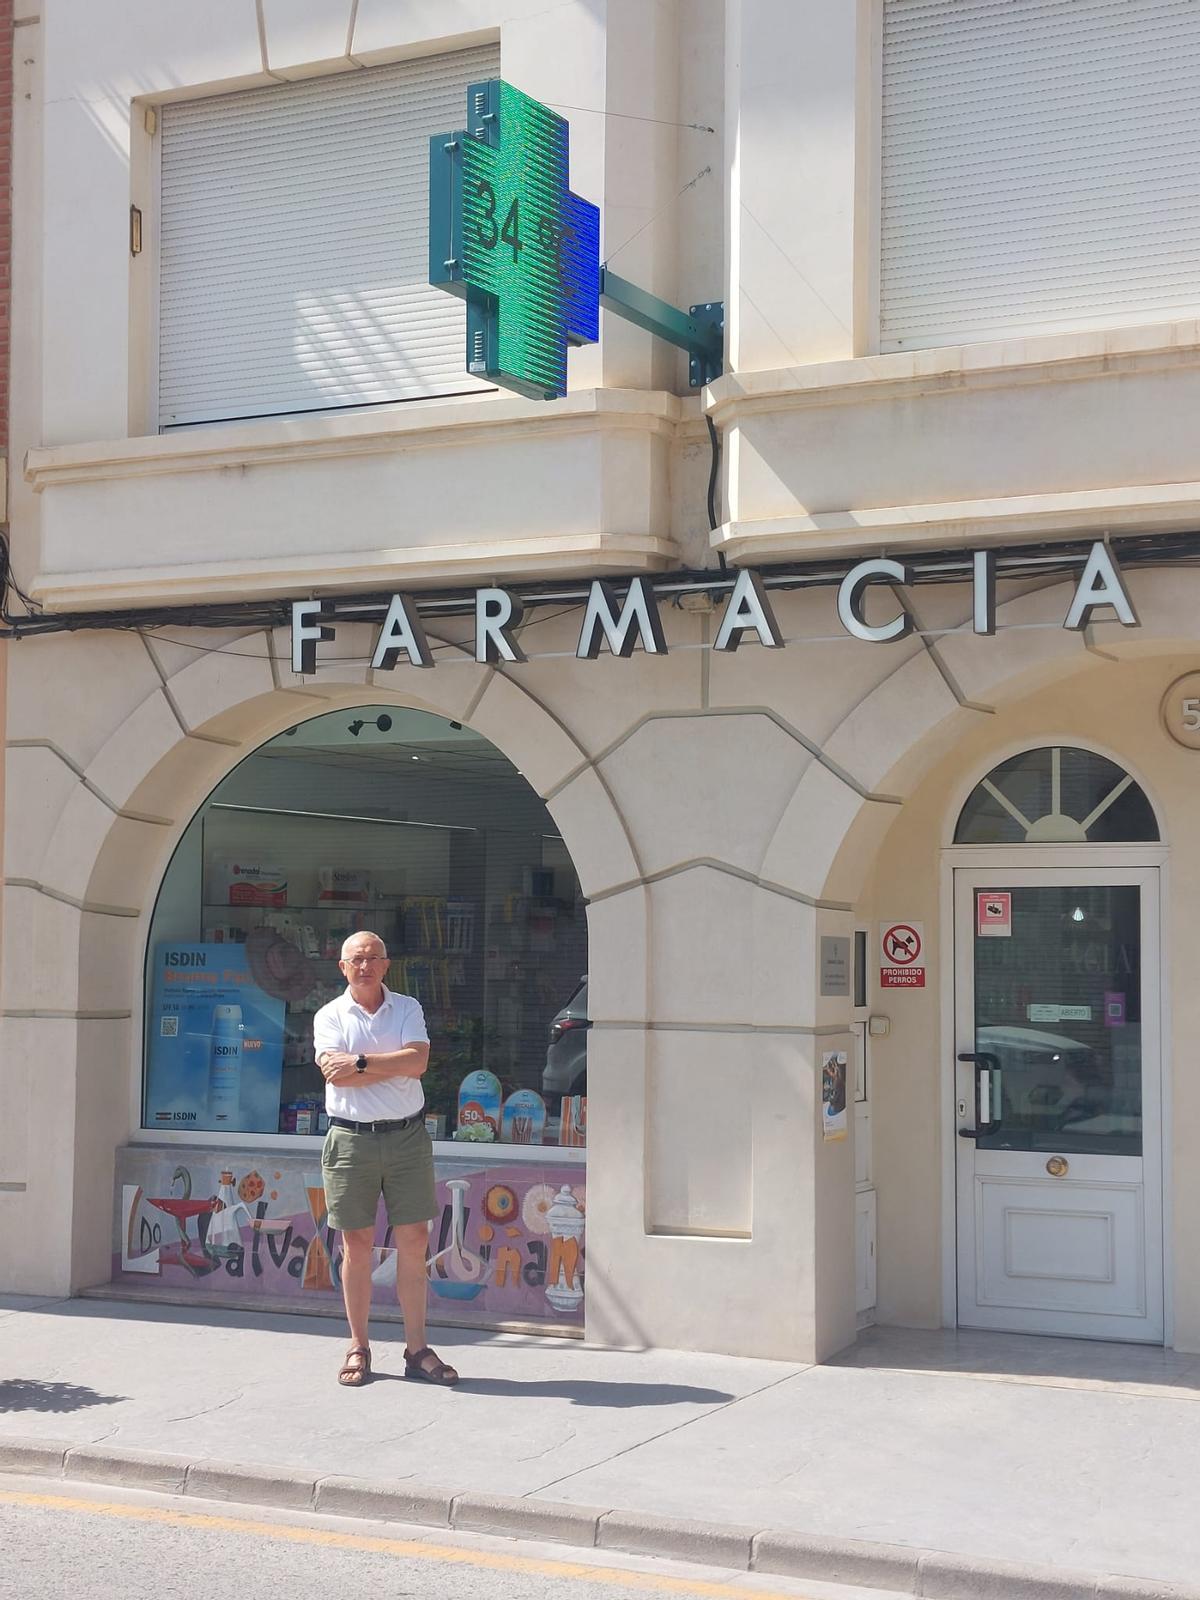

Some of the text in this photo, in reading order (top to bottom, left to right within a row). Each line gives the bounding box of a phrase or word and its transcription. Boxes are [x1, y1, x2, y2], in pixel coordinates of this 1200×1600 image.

[291, 540, 1141, 675] FARMACIA
[164, 952, 207, 966] ISDIN
[882, 968, 922, 976] PROHIBIDO
[888, 976, 917, 984] PERROS
[214, 1046, 239, 1055] ISDIN
[173, 1112, 197, 1120] ISDIN
